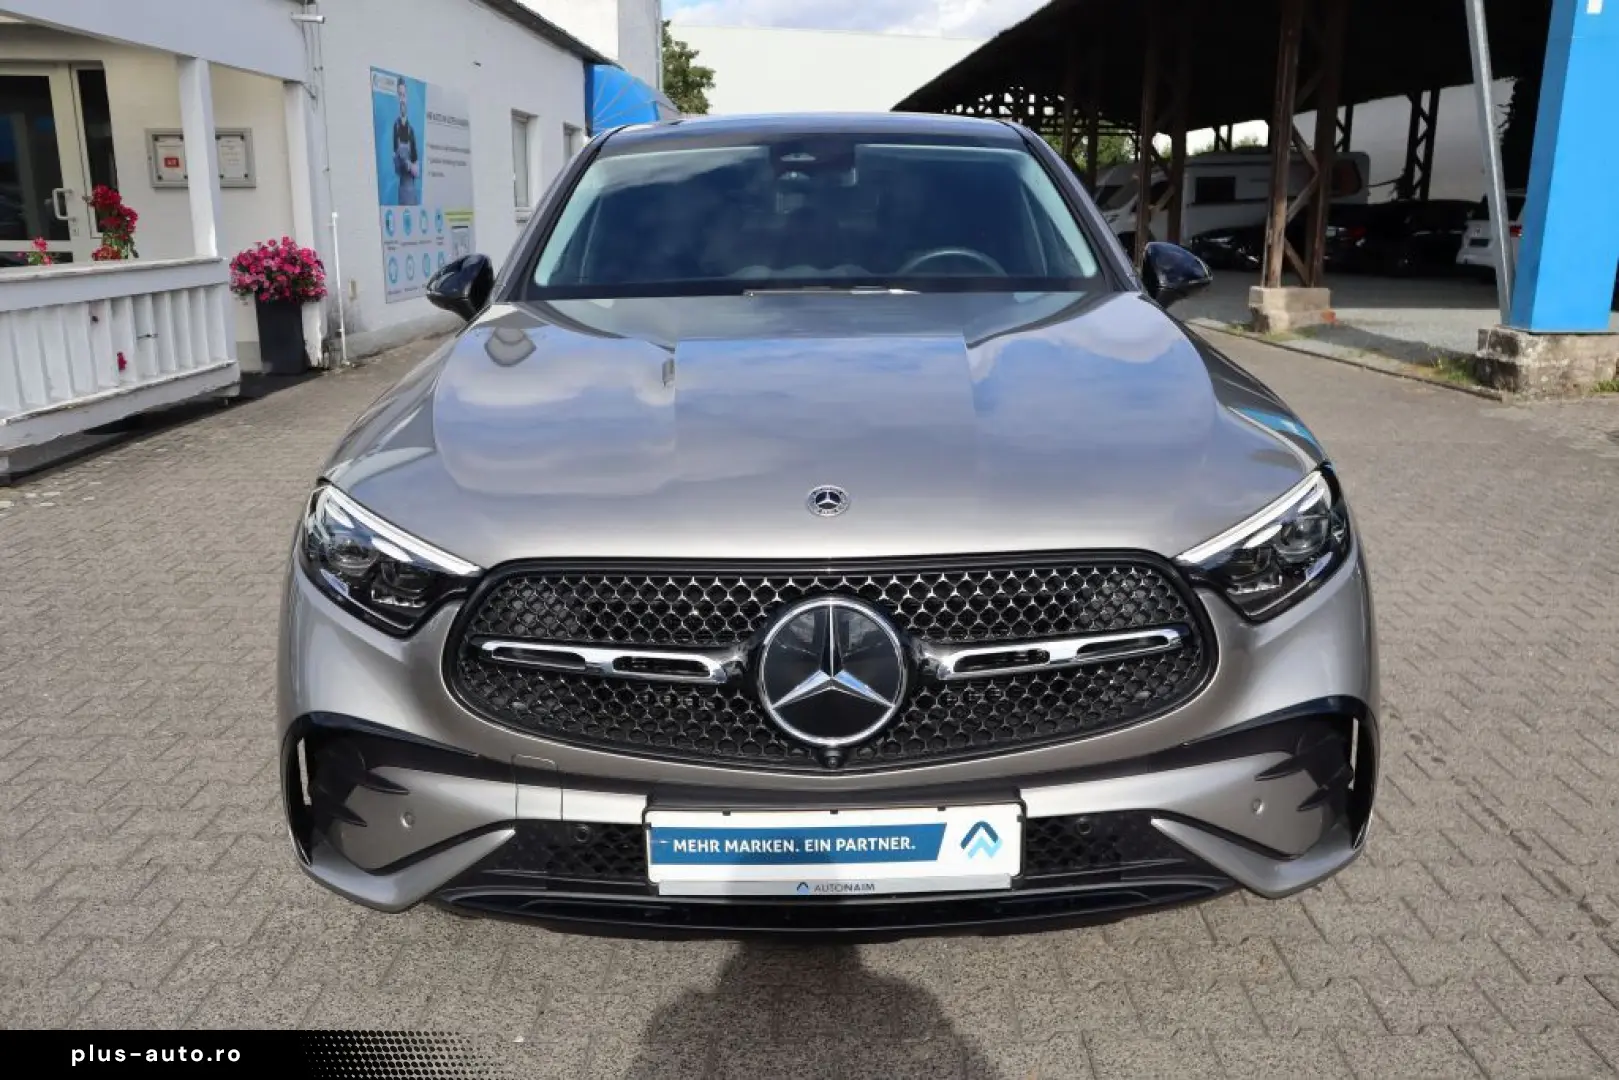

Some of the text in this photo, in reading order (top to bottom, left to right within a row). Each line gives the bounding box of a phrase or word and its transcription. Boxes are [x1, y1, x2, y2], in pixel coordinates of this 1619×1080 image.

[673, 836, 916, 853] MEHR MARKEN. EIN PARTNER.
[814, 882, 875, 893] AUTONAIM
